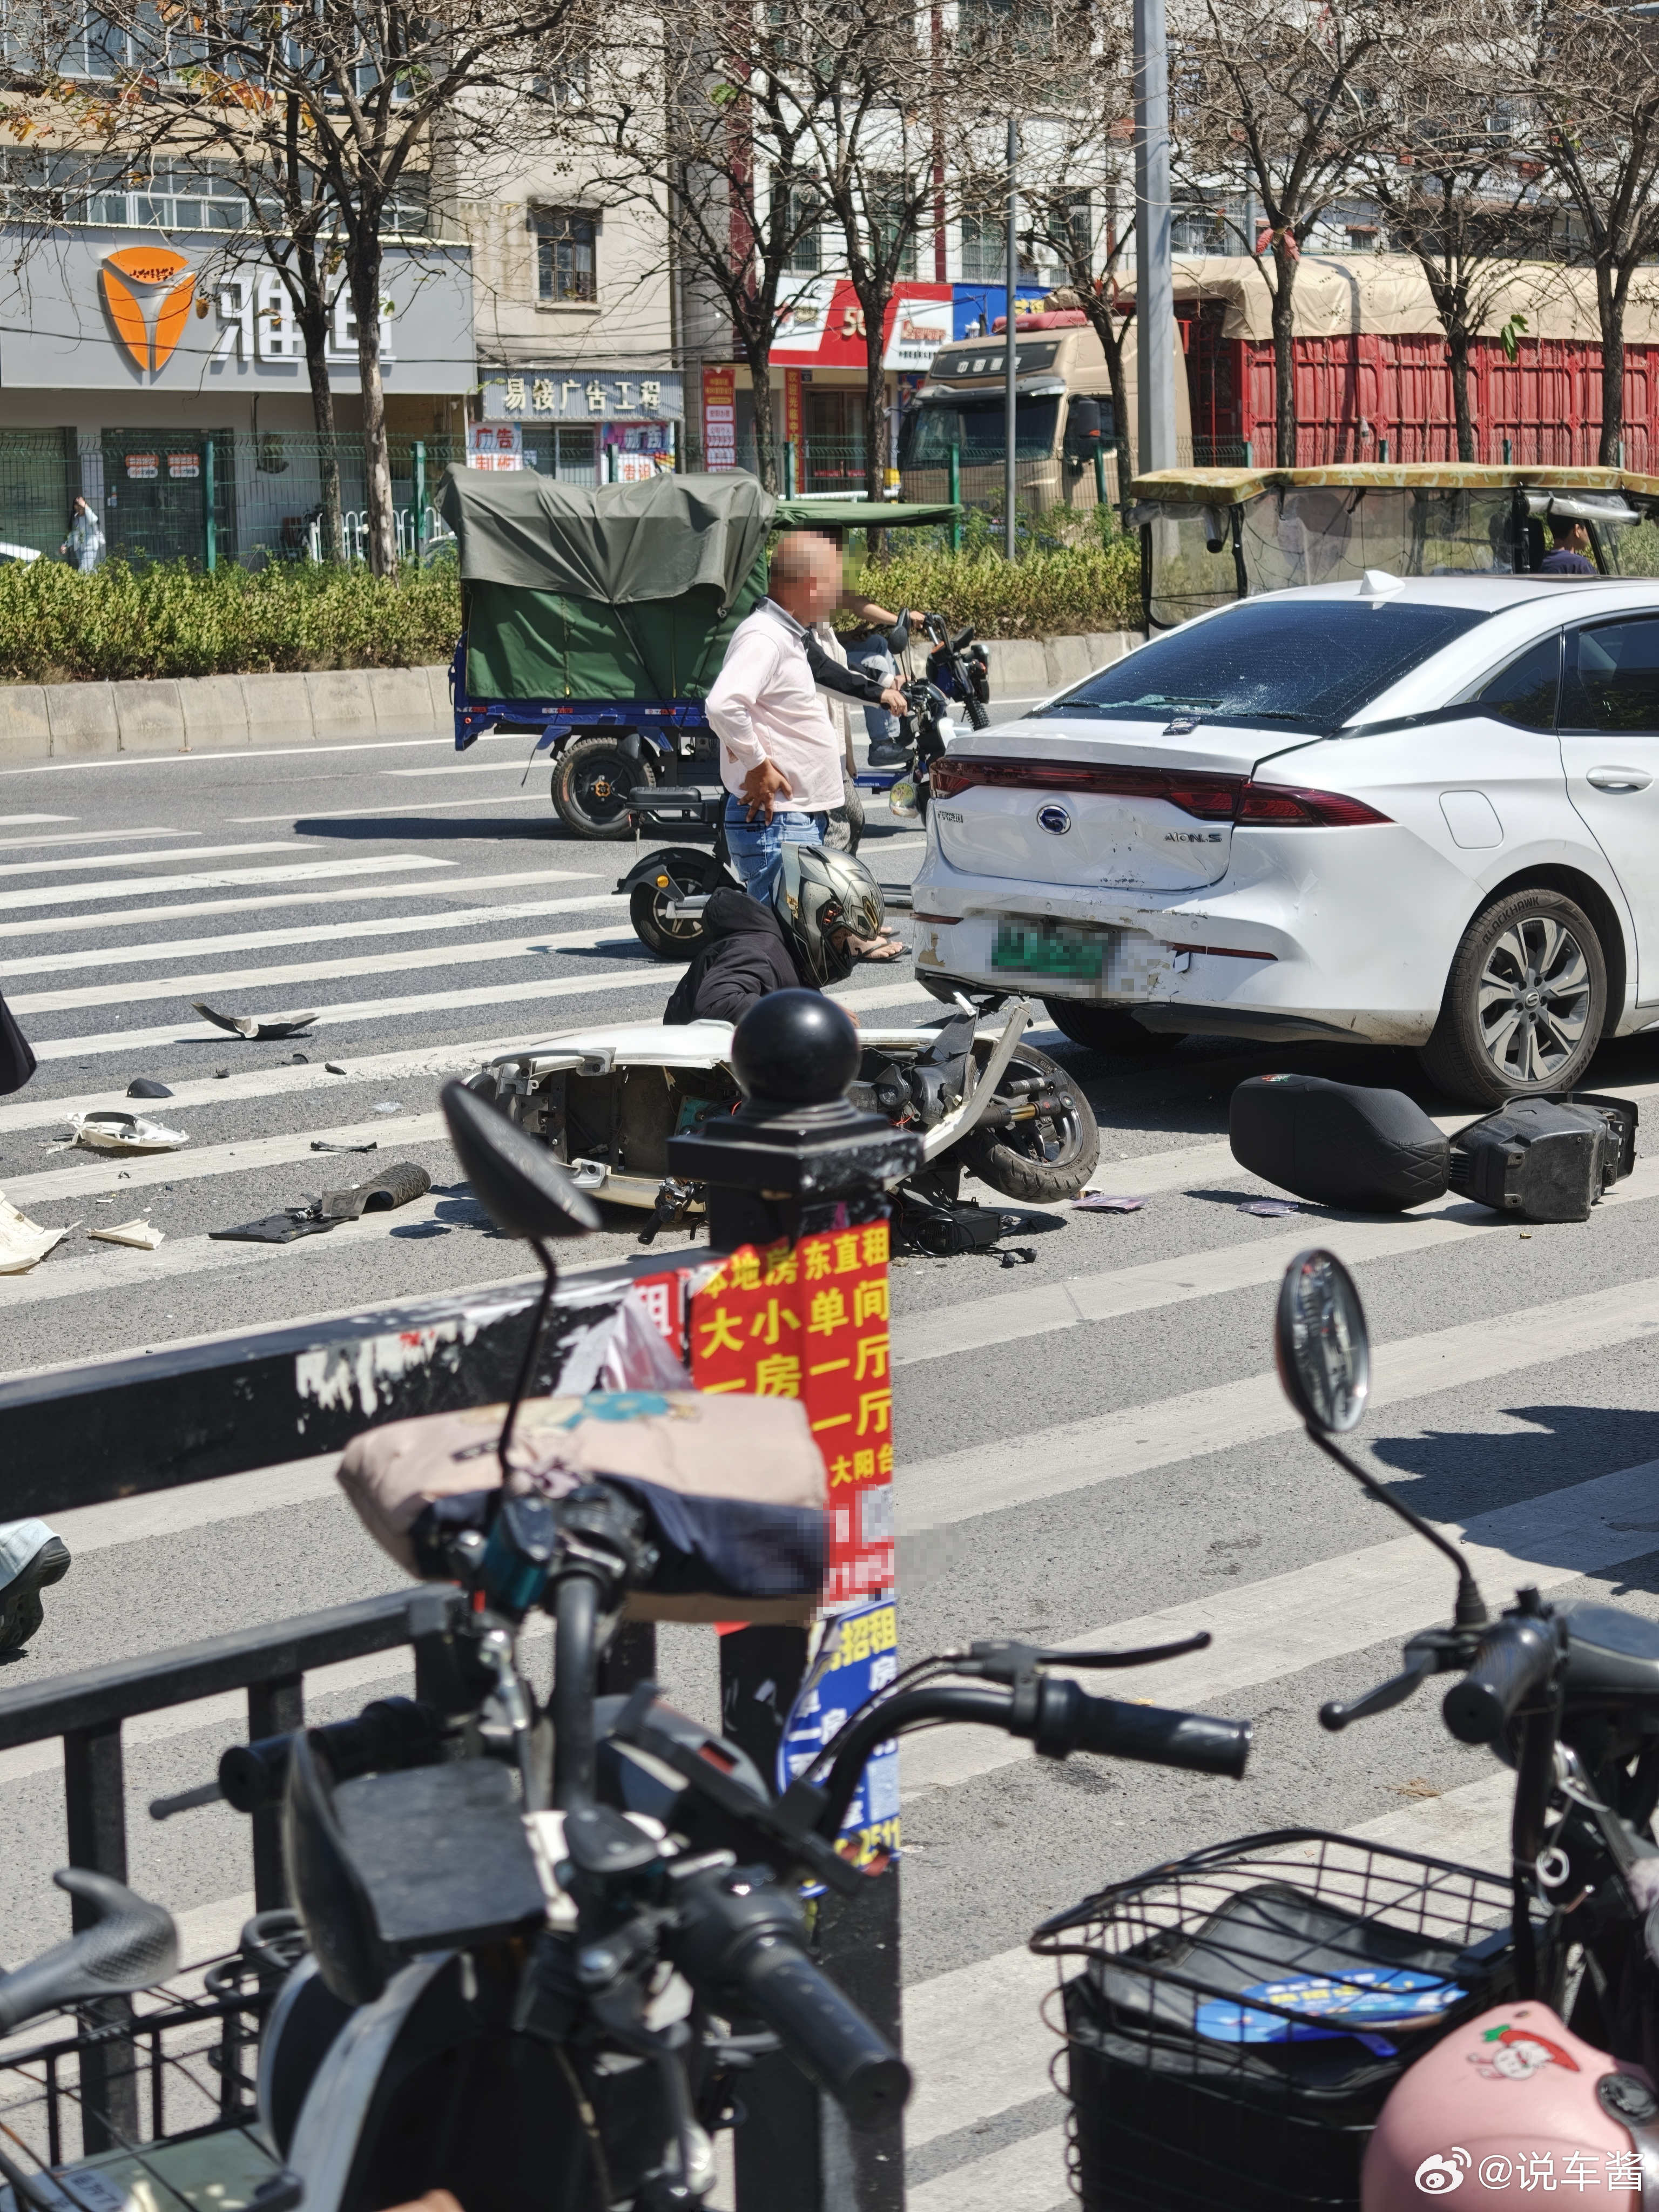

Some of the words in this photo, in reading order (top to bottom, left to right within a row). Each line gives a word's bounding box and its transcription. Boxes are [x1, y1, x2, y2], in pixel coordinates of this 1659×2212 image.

[504, 377, 661, 411] 易接广告工程
[476, 428, 514, 448] 广告
[1482, 896, 1540, 945] BLACKHAWK
[699, 1277, 889, 1359] 大小单间
[830, 1443, 893, 1488] 大阳台
